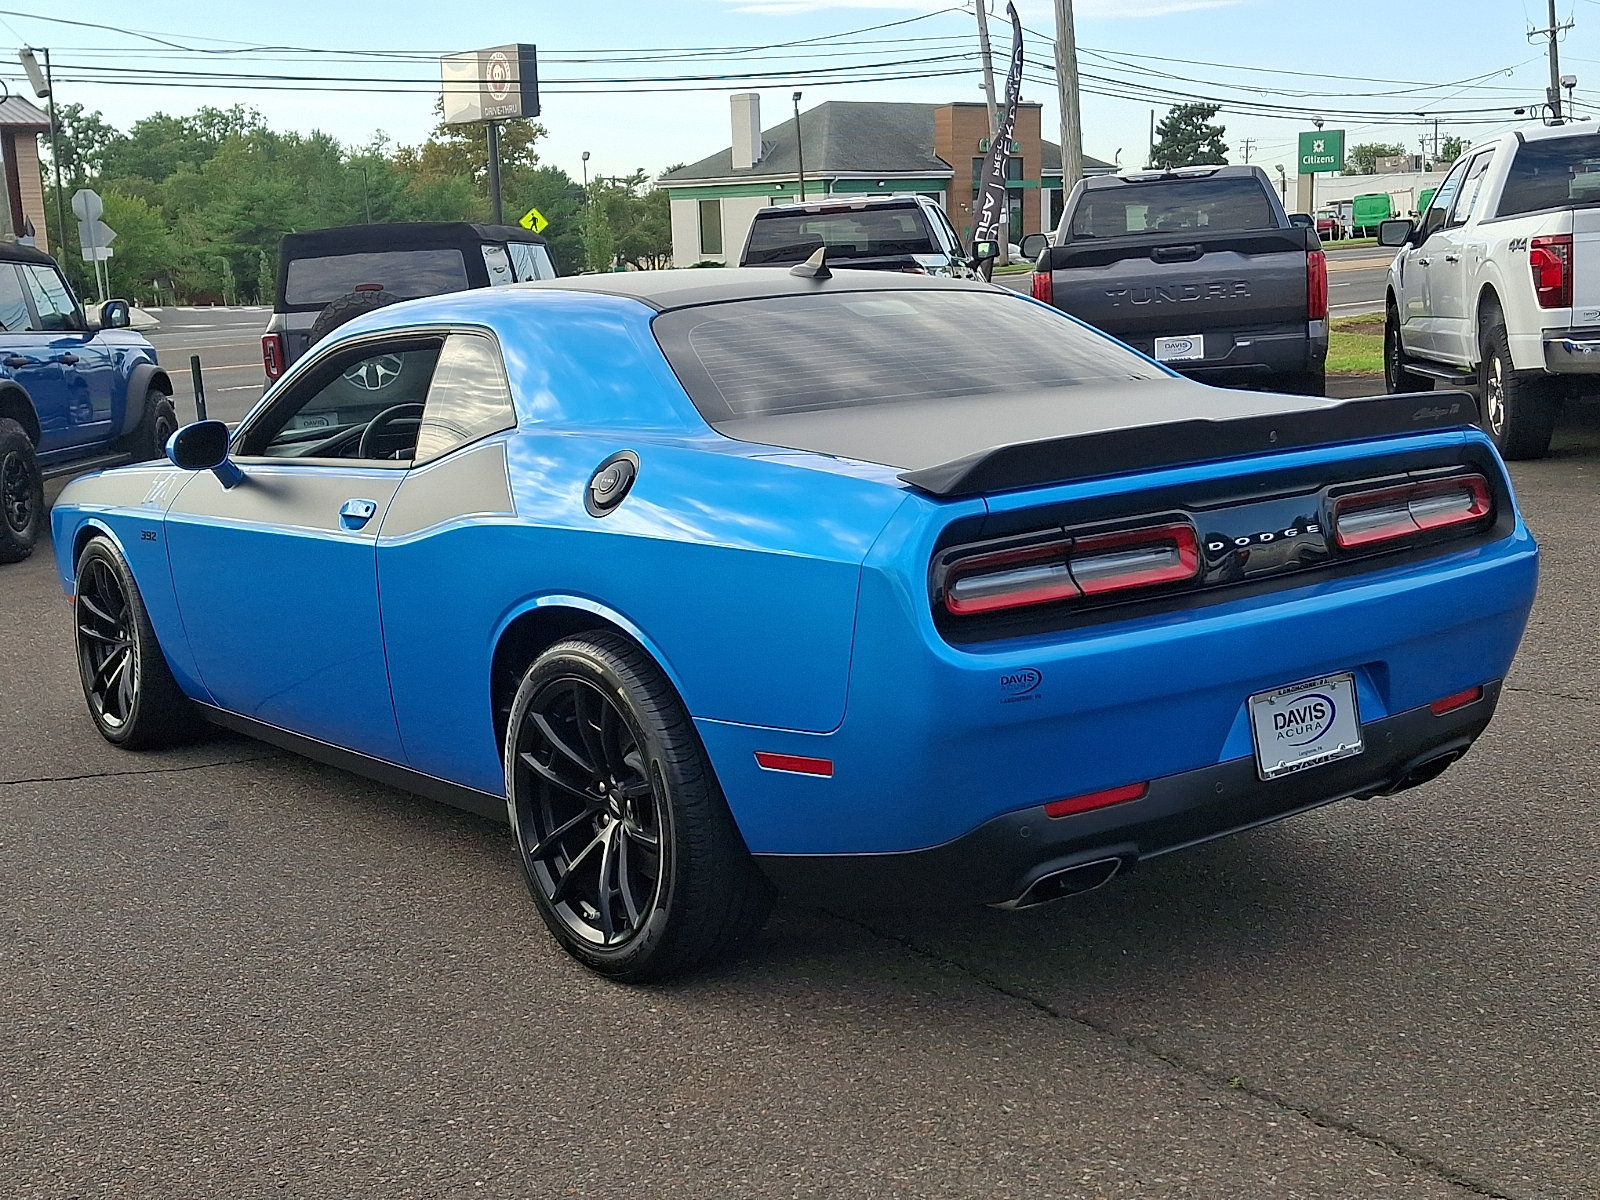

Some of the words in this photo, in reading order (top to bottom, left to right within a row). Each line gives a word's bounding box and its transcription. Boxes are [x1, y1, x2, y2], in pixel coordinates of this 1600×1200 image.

[485, 104, 517, 116] DRIVE-THRU
[1303, 155, 1335, 165] Citizens
[1105, 280, 1251, 307] TUNDRA
[1164, 342, 1188, 350] DAVIS
[140, 529, 157, 542] 392
[1208, 524, 1320, 551] DODGE
[1000, 672, 1035, 686] DAVIS
[1273, 702, 1326, 731] DAVIS
[1276, 721, 1323, 741] ACURA
[1288, 752, 1341, 772] DAVIS
